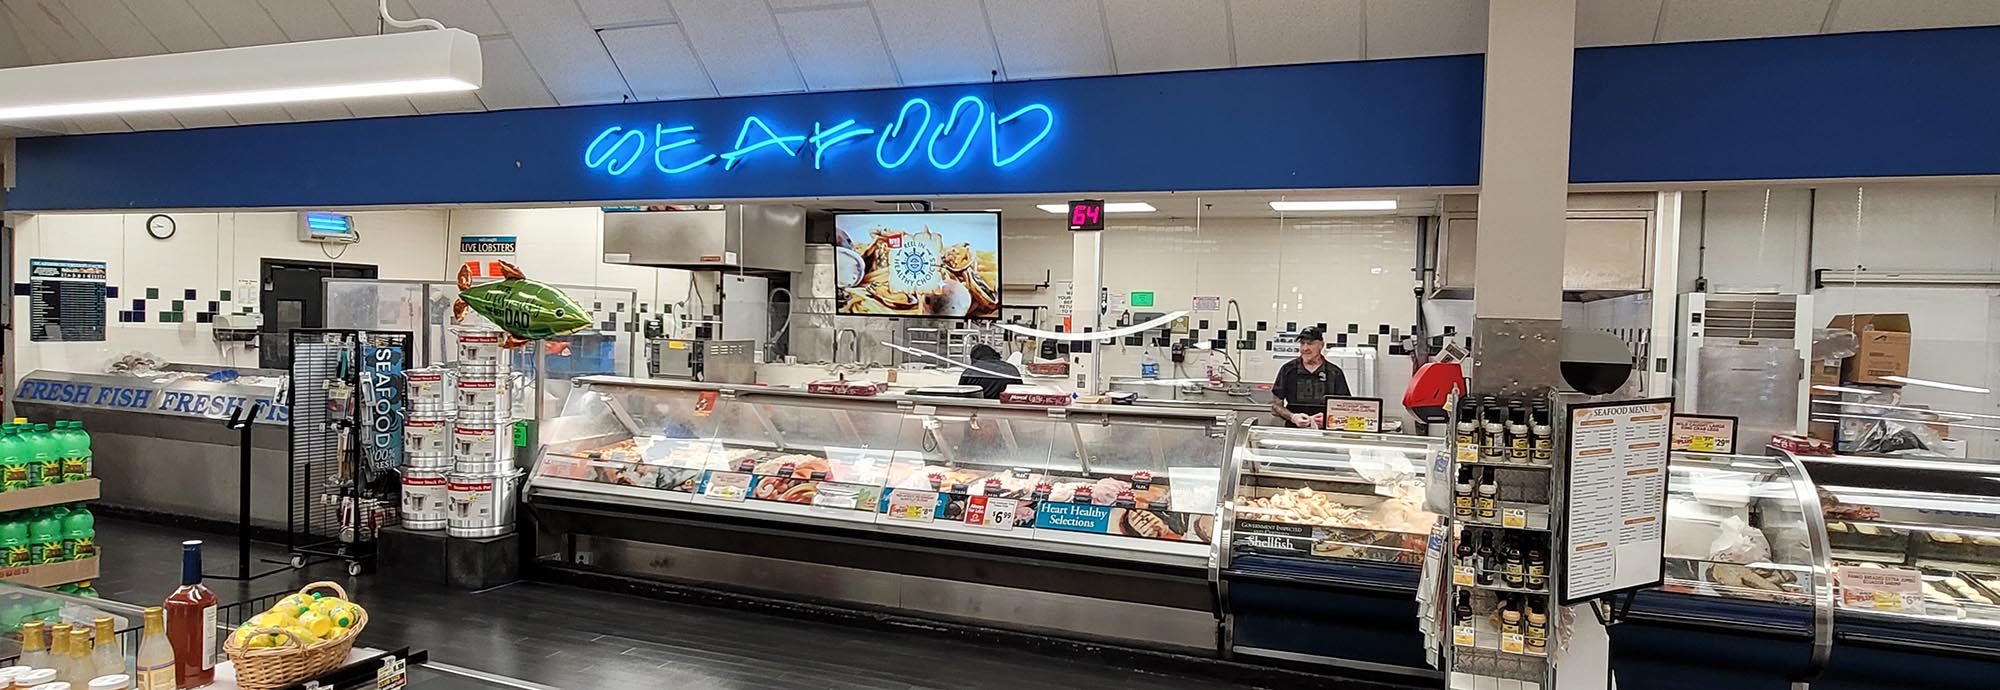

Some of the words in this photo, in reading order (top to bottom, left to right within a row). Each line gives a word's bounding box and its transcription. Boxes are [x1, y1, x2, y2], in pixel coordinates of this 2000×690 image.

[585, 96, 1053, 175] SEAFOOD
[1073, 205, 1099, 225] 64
[461, 243, 477, 252] LIVE
[478, 243, 515, 252] LOBSTERS
[894, 258, 915, 286] HEALTHY
[916, 257, 936, 286] CHOICES
[505, 308, 530, 329] DAD
[16, 380, 92, 404] FRESH
[95, 386, 153, 409] FISH
[159, 391, 246, 418] FRESH
[254, 398, 288, 422] FIS
[375, 348, 391, 448] SEAFOOD
[1593, 407, 1628, 417] SEAFOOD
[1629, 406, 1649, 414] MENU
[373, 449, 395, 461] 00%
[1041, 502, 1068, 514] Heart
[1070, 505, 1108, 520] Healthy
[1049, 514, 1095, 528] Selections
[1247, 535, 1296, 550] Shellfish
